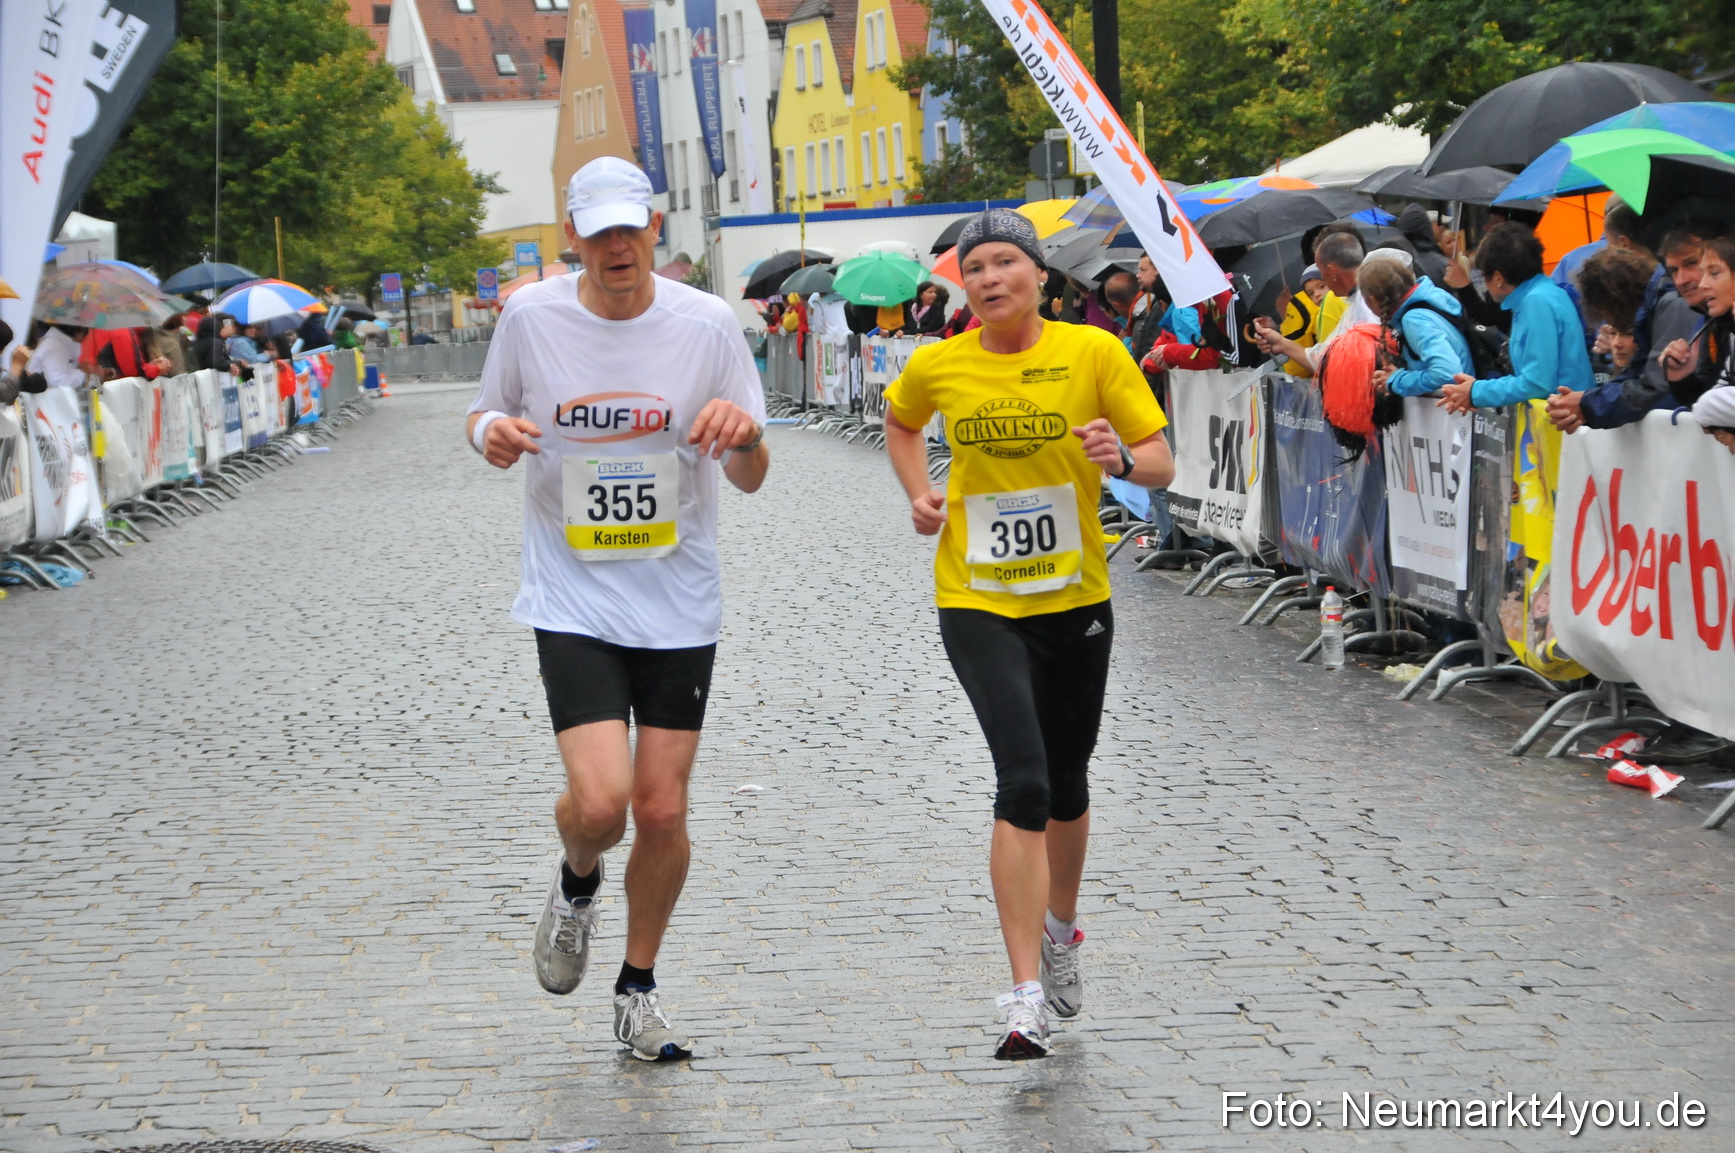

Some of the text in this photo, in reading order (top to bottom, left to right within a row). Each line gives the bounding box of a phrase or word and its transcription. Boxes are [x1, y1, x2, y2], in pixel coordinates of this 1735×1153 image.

[101, 24, 137, 79] SWEDEN
[702, 63, 722, 160] K&L RUPPERT
[22, 70, 54, 185] Audi
[384, 291, 402, 302] TAXI
[480, 288, 497, 302] TAXI
[555, 403, 671, 431] LAUF10!
[976, 400, 1038, 418] PIZZERIA
[965, 416, 1054, 441] FRANCESCO
[598, 462, 644, 474] BOCK
[587, 483, 657, 521] 355
[997, 494, 1040, 510] BOCK
[593, 530, 650, 546] Karsten
[991, 514, 1057, 558] 390
[994, 560, 1056, 581] Cornelia
[1571, 467, 1735, 651] Oberb
